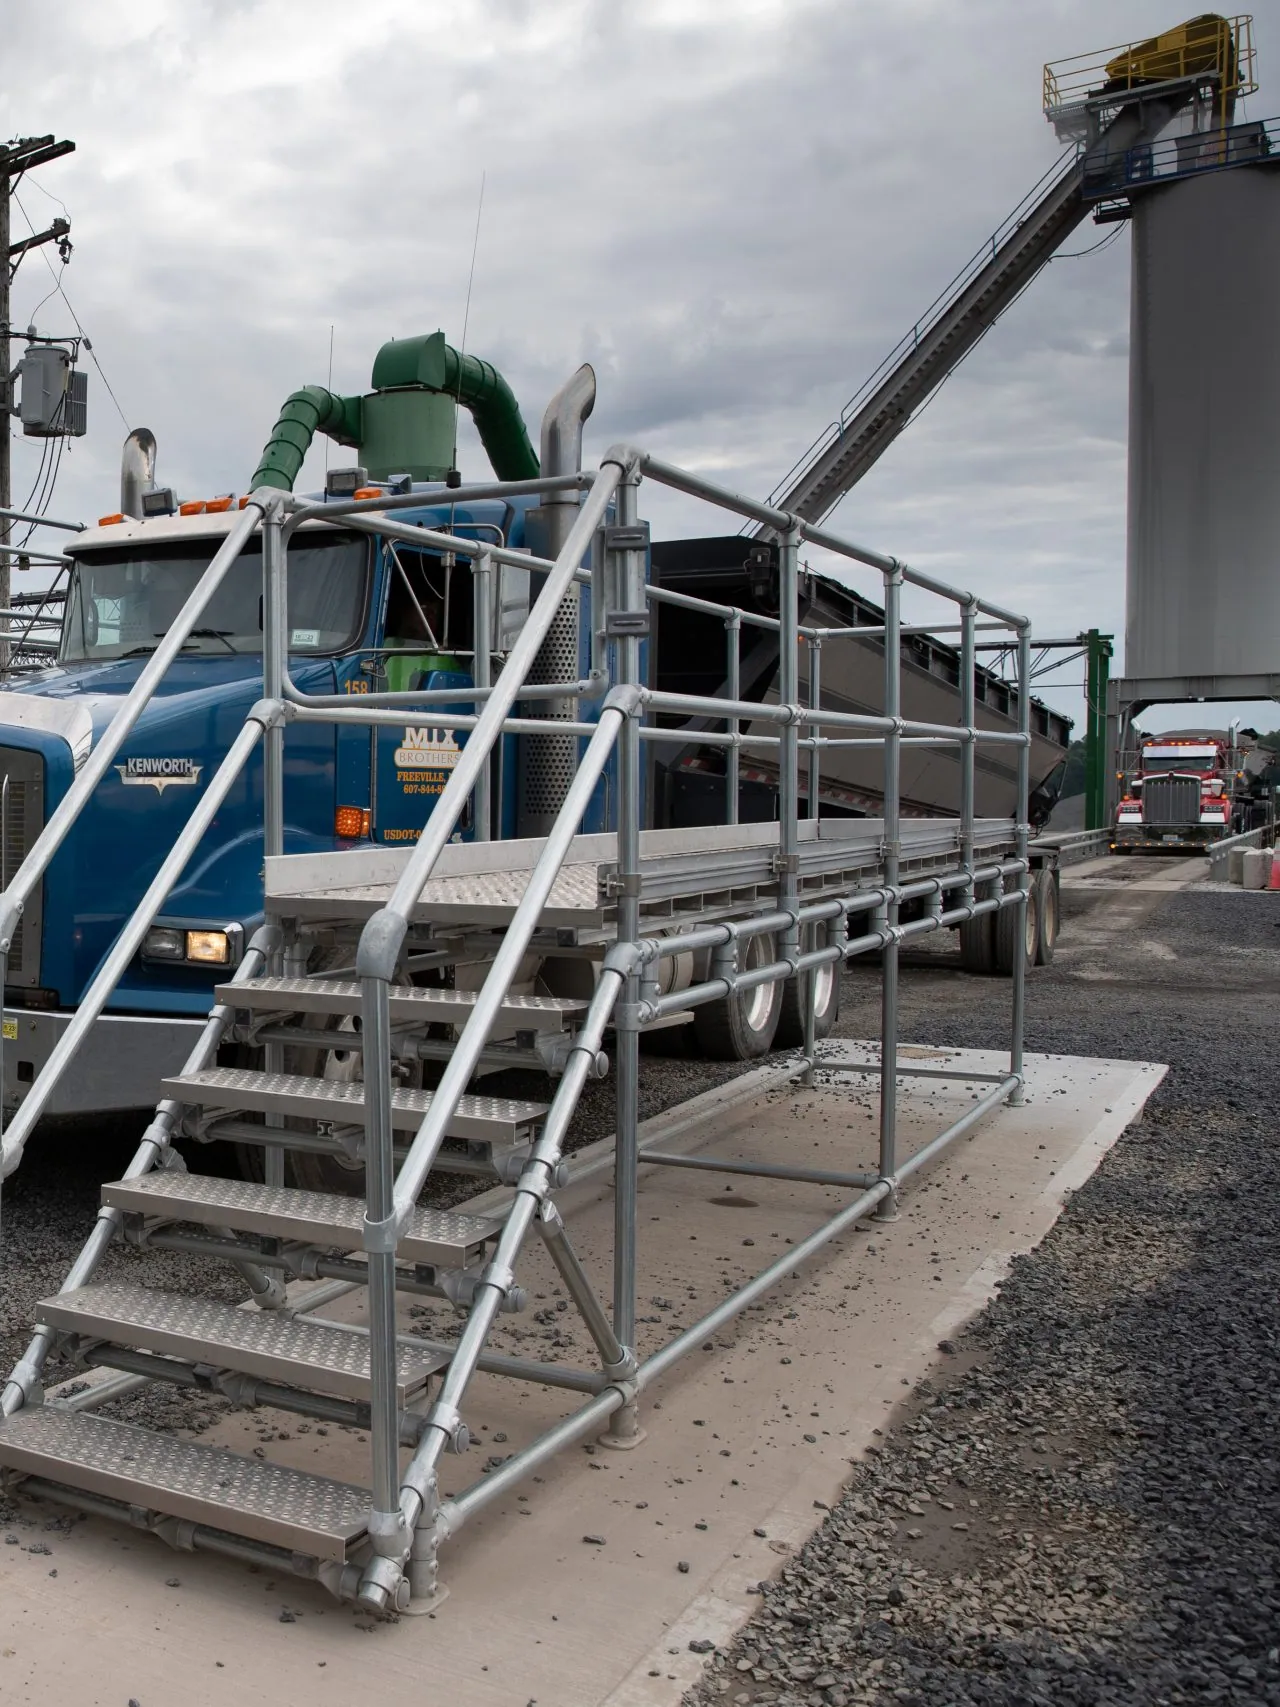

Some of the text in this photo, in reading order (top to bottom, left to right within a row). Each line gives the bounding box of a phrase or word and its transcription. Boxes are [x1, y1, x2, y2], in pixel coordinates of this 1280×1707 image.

[345, 680, 368, 696] 158
[402, 727, 459, 750] MIX
[127, 758, 193, 773] KENWORTH
[399, 752, 461, 765] BROTHERS
[397, 771, 447, 783] FREEVILLE,
